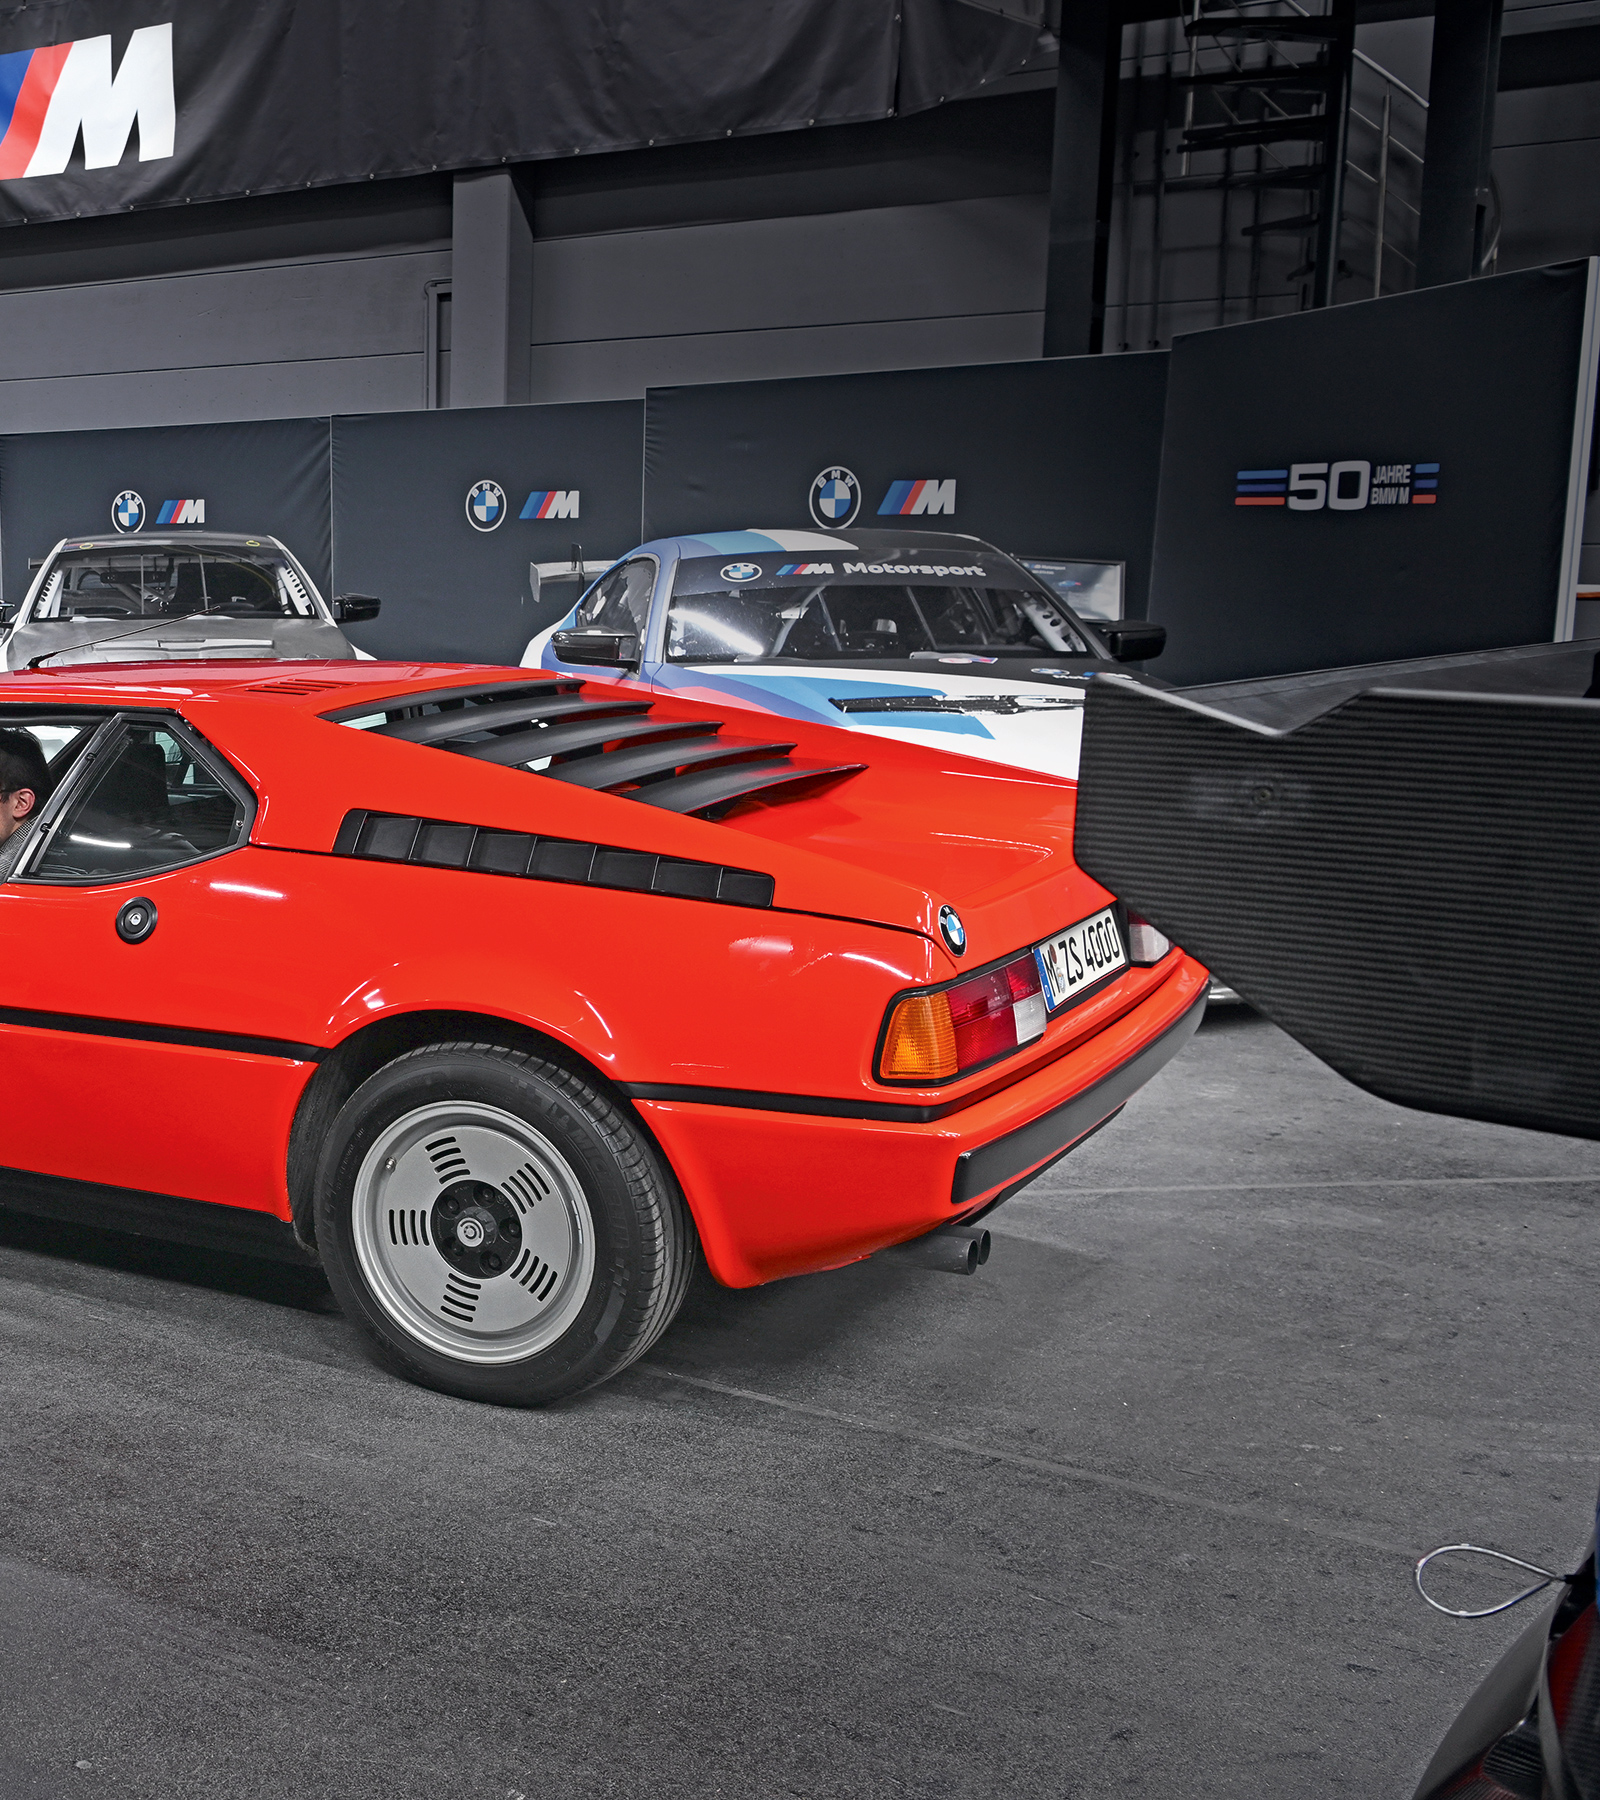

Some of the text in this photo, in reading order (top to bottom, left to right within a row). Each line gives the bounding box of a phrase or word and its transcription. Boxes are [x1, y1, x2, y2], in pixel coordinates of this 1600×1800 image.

[21, 21, 177, 179] M
[1287, 460, 1371, 511] 50
[1372, 464, 1412, 485] JAHRE
[544, 489, 580, 519] M
[909, 478, 957, 515] M
[1371, 486, 1410, 505] BMW M
[176, 498, 205, 524] M
[800, 562, 987, 577] M Motorsport
[1042, 949, 1061, 997] M
[1058, 936, 1084, 986] ZS
[1082, 916, 1120, 972] 4000
